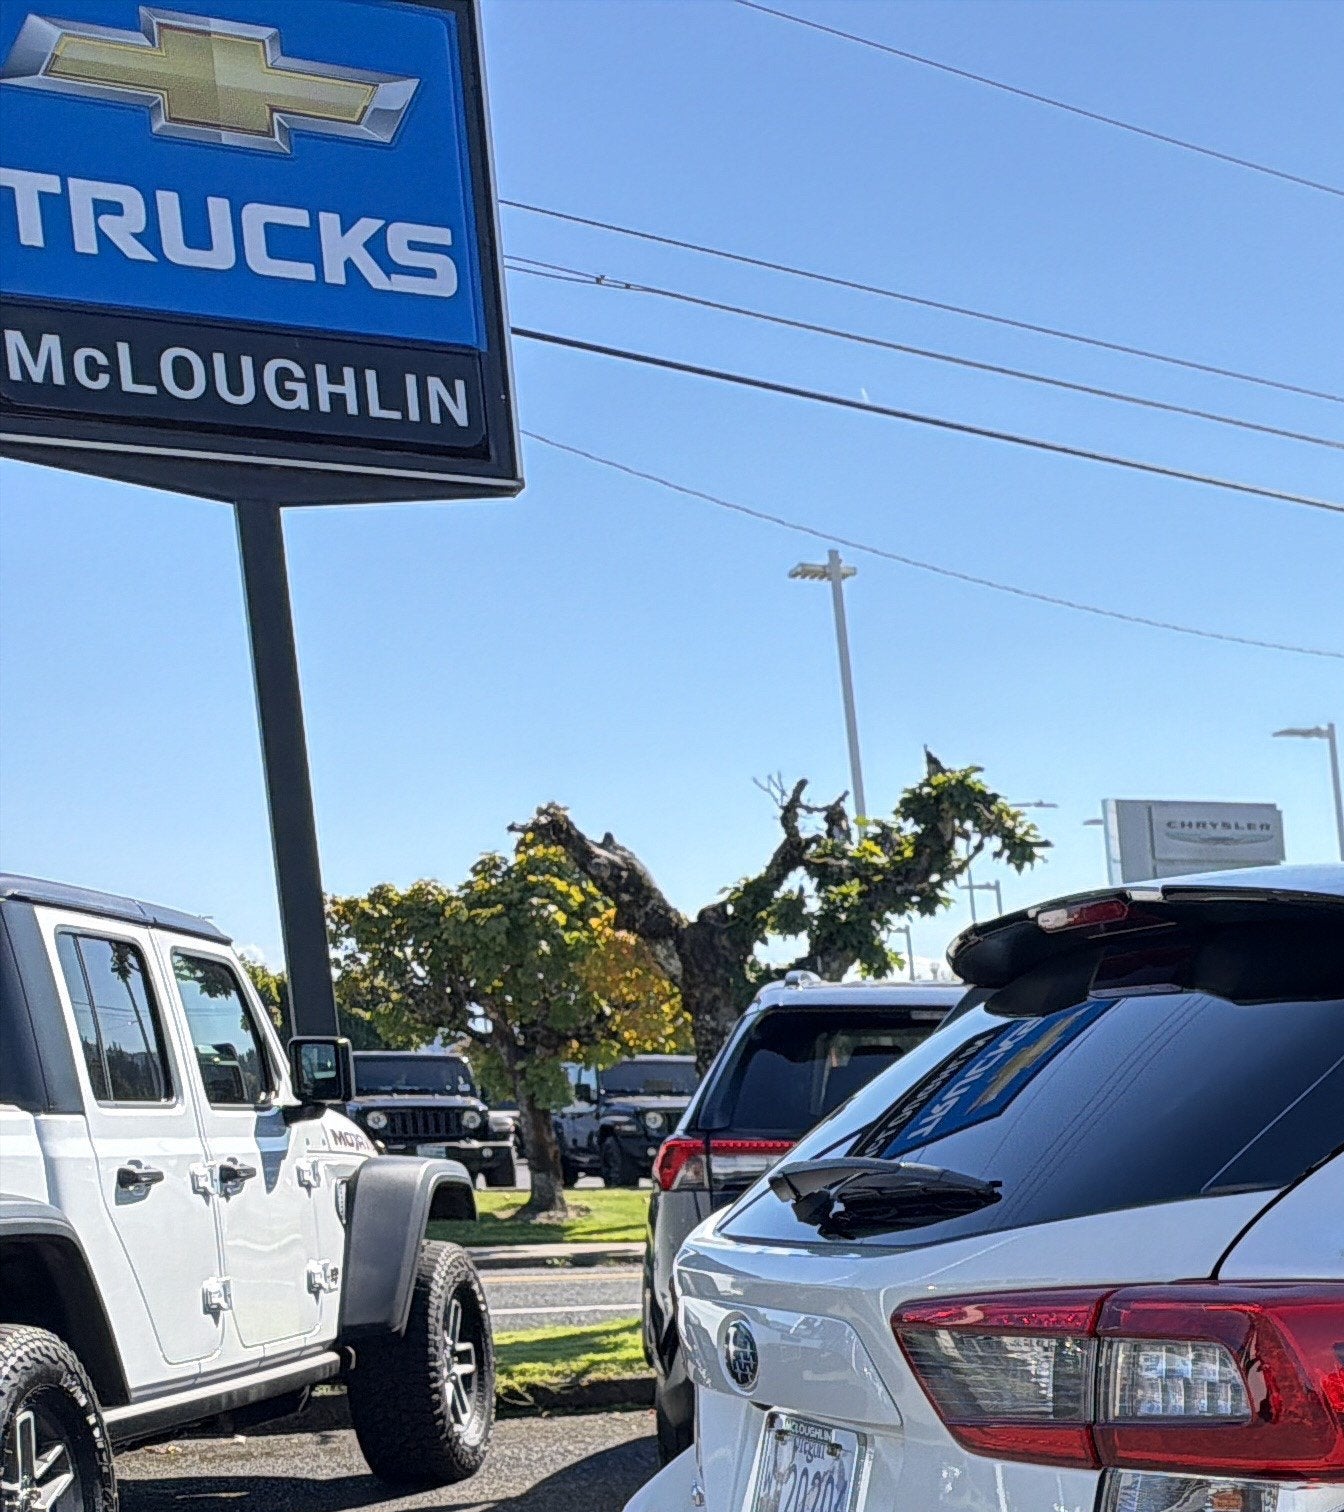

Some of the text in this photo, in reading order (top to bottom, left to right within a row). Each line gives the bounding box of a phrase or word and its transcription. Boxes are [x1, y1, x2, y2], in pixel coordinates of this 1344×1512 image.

[0, 168, 458, 298] TRUCKS
[3, 328, 470, 428] McLOUGHLIN
[1166, 820, 1272, 832] CHRYSLER
